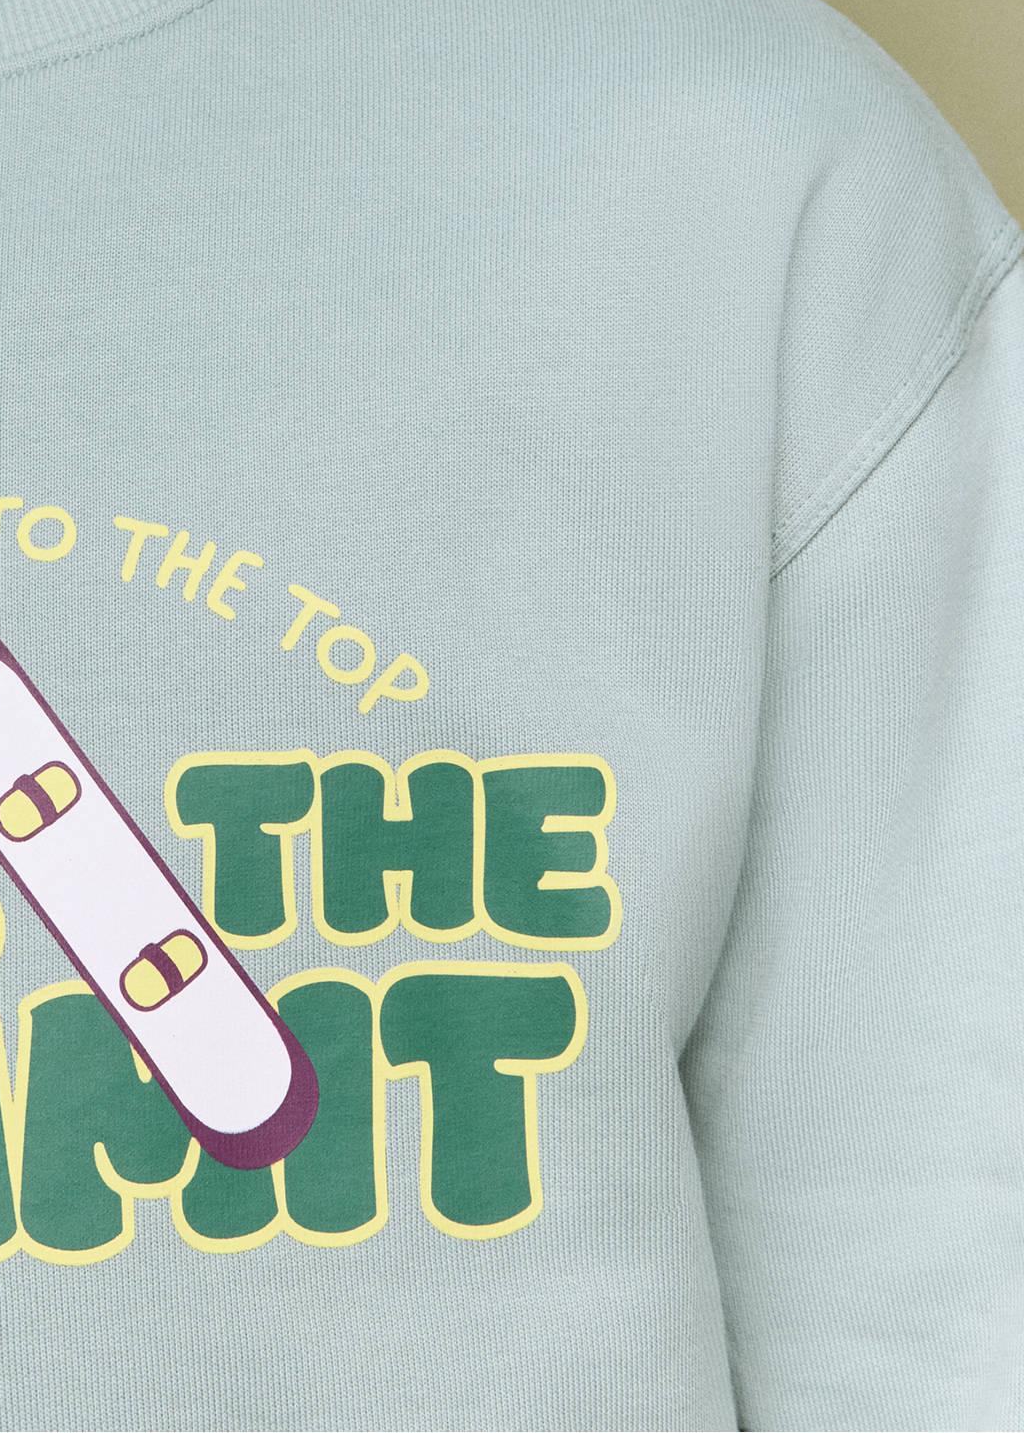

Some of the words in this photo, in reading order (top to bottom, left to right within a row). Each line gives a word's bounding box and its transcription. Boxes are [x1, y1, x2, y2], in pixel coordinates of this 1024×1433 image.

[113, 515, 264, 621] THE
[280, 584, 430, 715] TOP
[164, 748, 623, 953] THE
